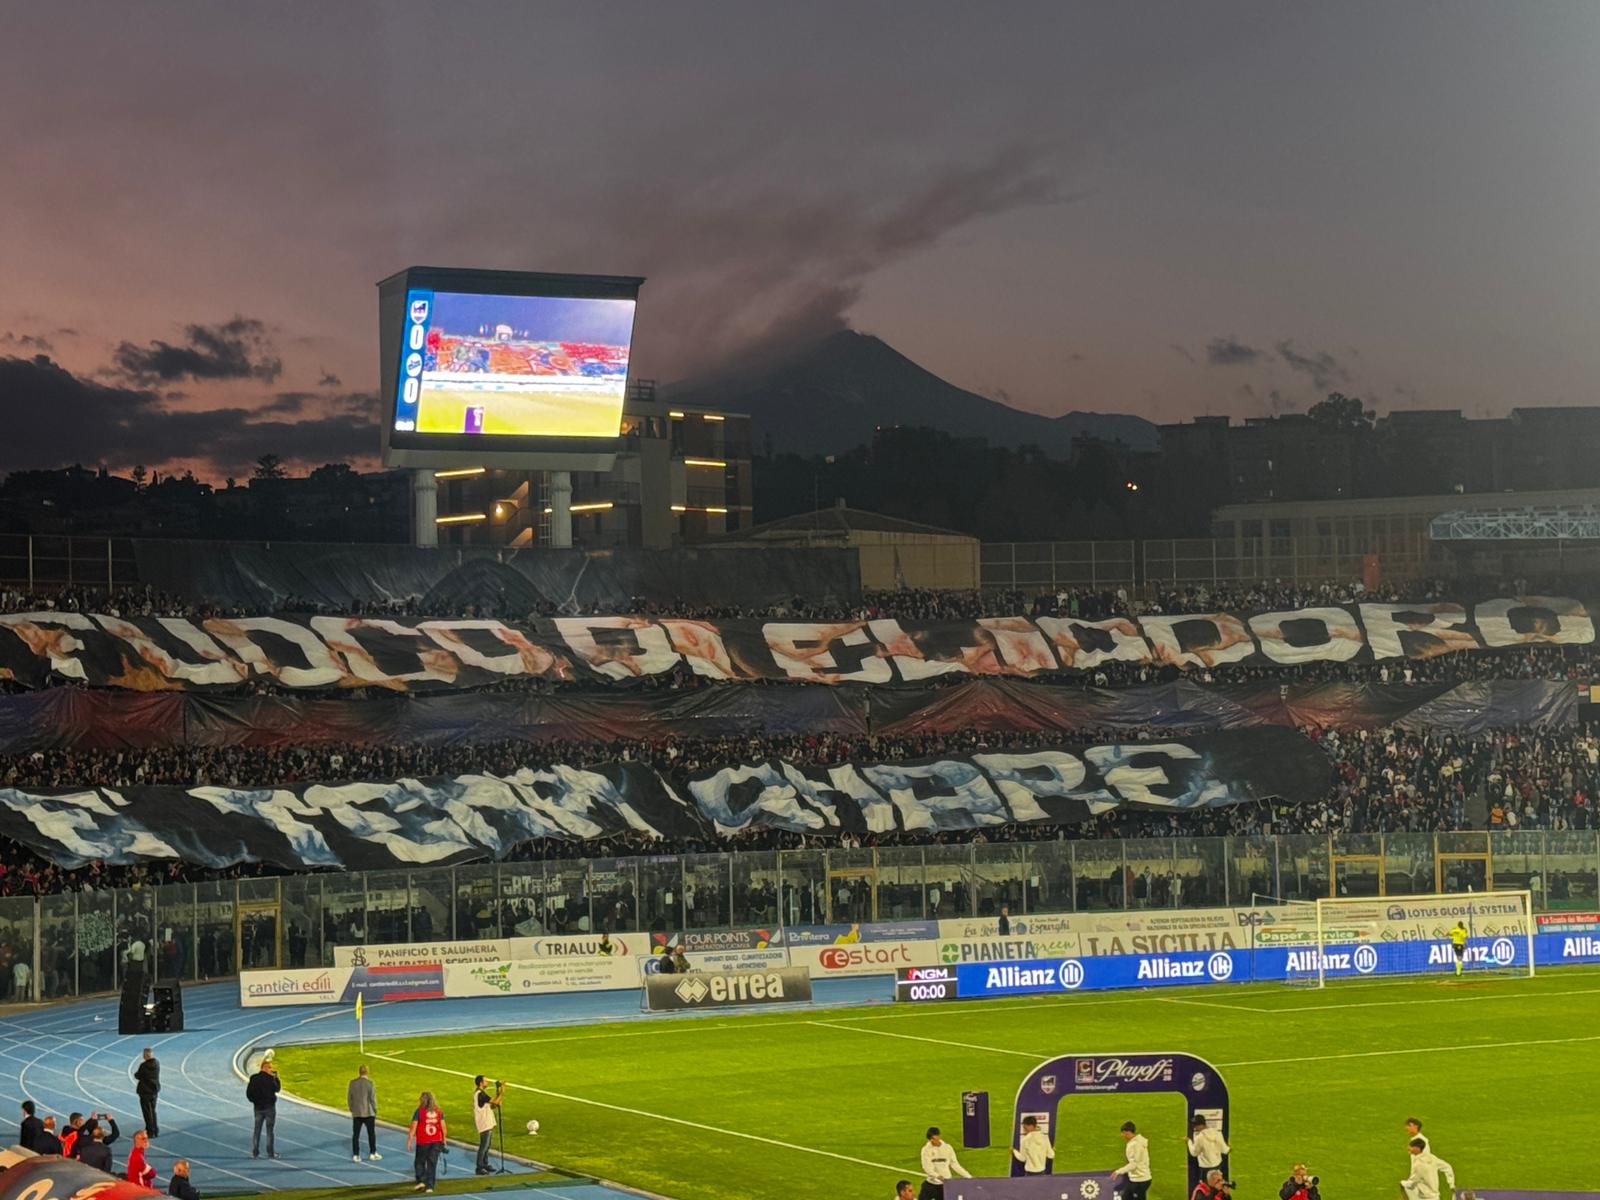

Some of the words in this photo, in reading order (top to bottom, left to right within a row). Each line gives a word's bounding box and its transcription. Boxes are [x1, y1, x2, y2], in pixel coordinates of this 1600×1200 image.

[762, 596, 1595, 684] ELIODORO
[1407, 907, 1438, 918] LOTUS
[1440, 905, 1477, 917] GLOBAL
[1479, 904, 1517, 914] SYSTEM
[685, 933, 714, 945] FOUR
[714, 931, 750, 943] POINTS
[1087, 936, 1126, 956] LA
[1131, 931, 1236, 954] SICILIA
[378, 947, 429, 958] PANIFICIO
[432, 947, 437, 955] E
[441, 944, 498, 955] SALUMERIA
[546, 942, 610, 956] TRIALU
[822, 943, 912, 966] restart
[961, 941, 1034, 961] PIANETA
[986, 967, 1055, 989] Allianz
[1137, 958, 1204, 979] Allianz
[248, 978, 299, 995] cantieri
[303, 976, 331, 991] edili
[710, 972, 785, 1002] errea
[910, 984, 946, 1000] 00:00
[1094, 1058, 1172, 1083] Playoff
